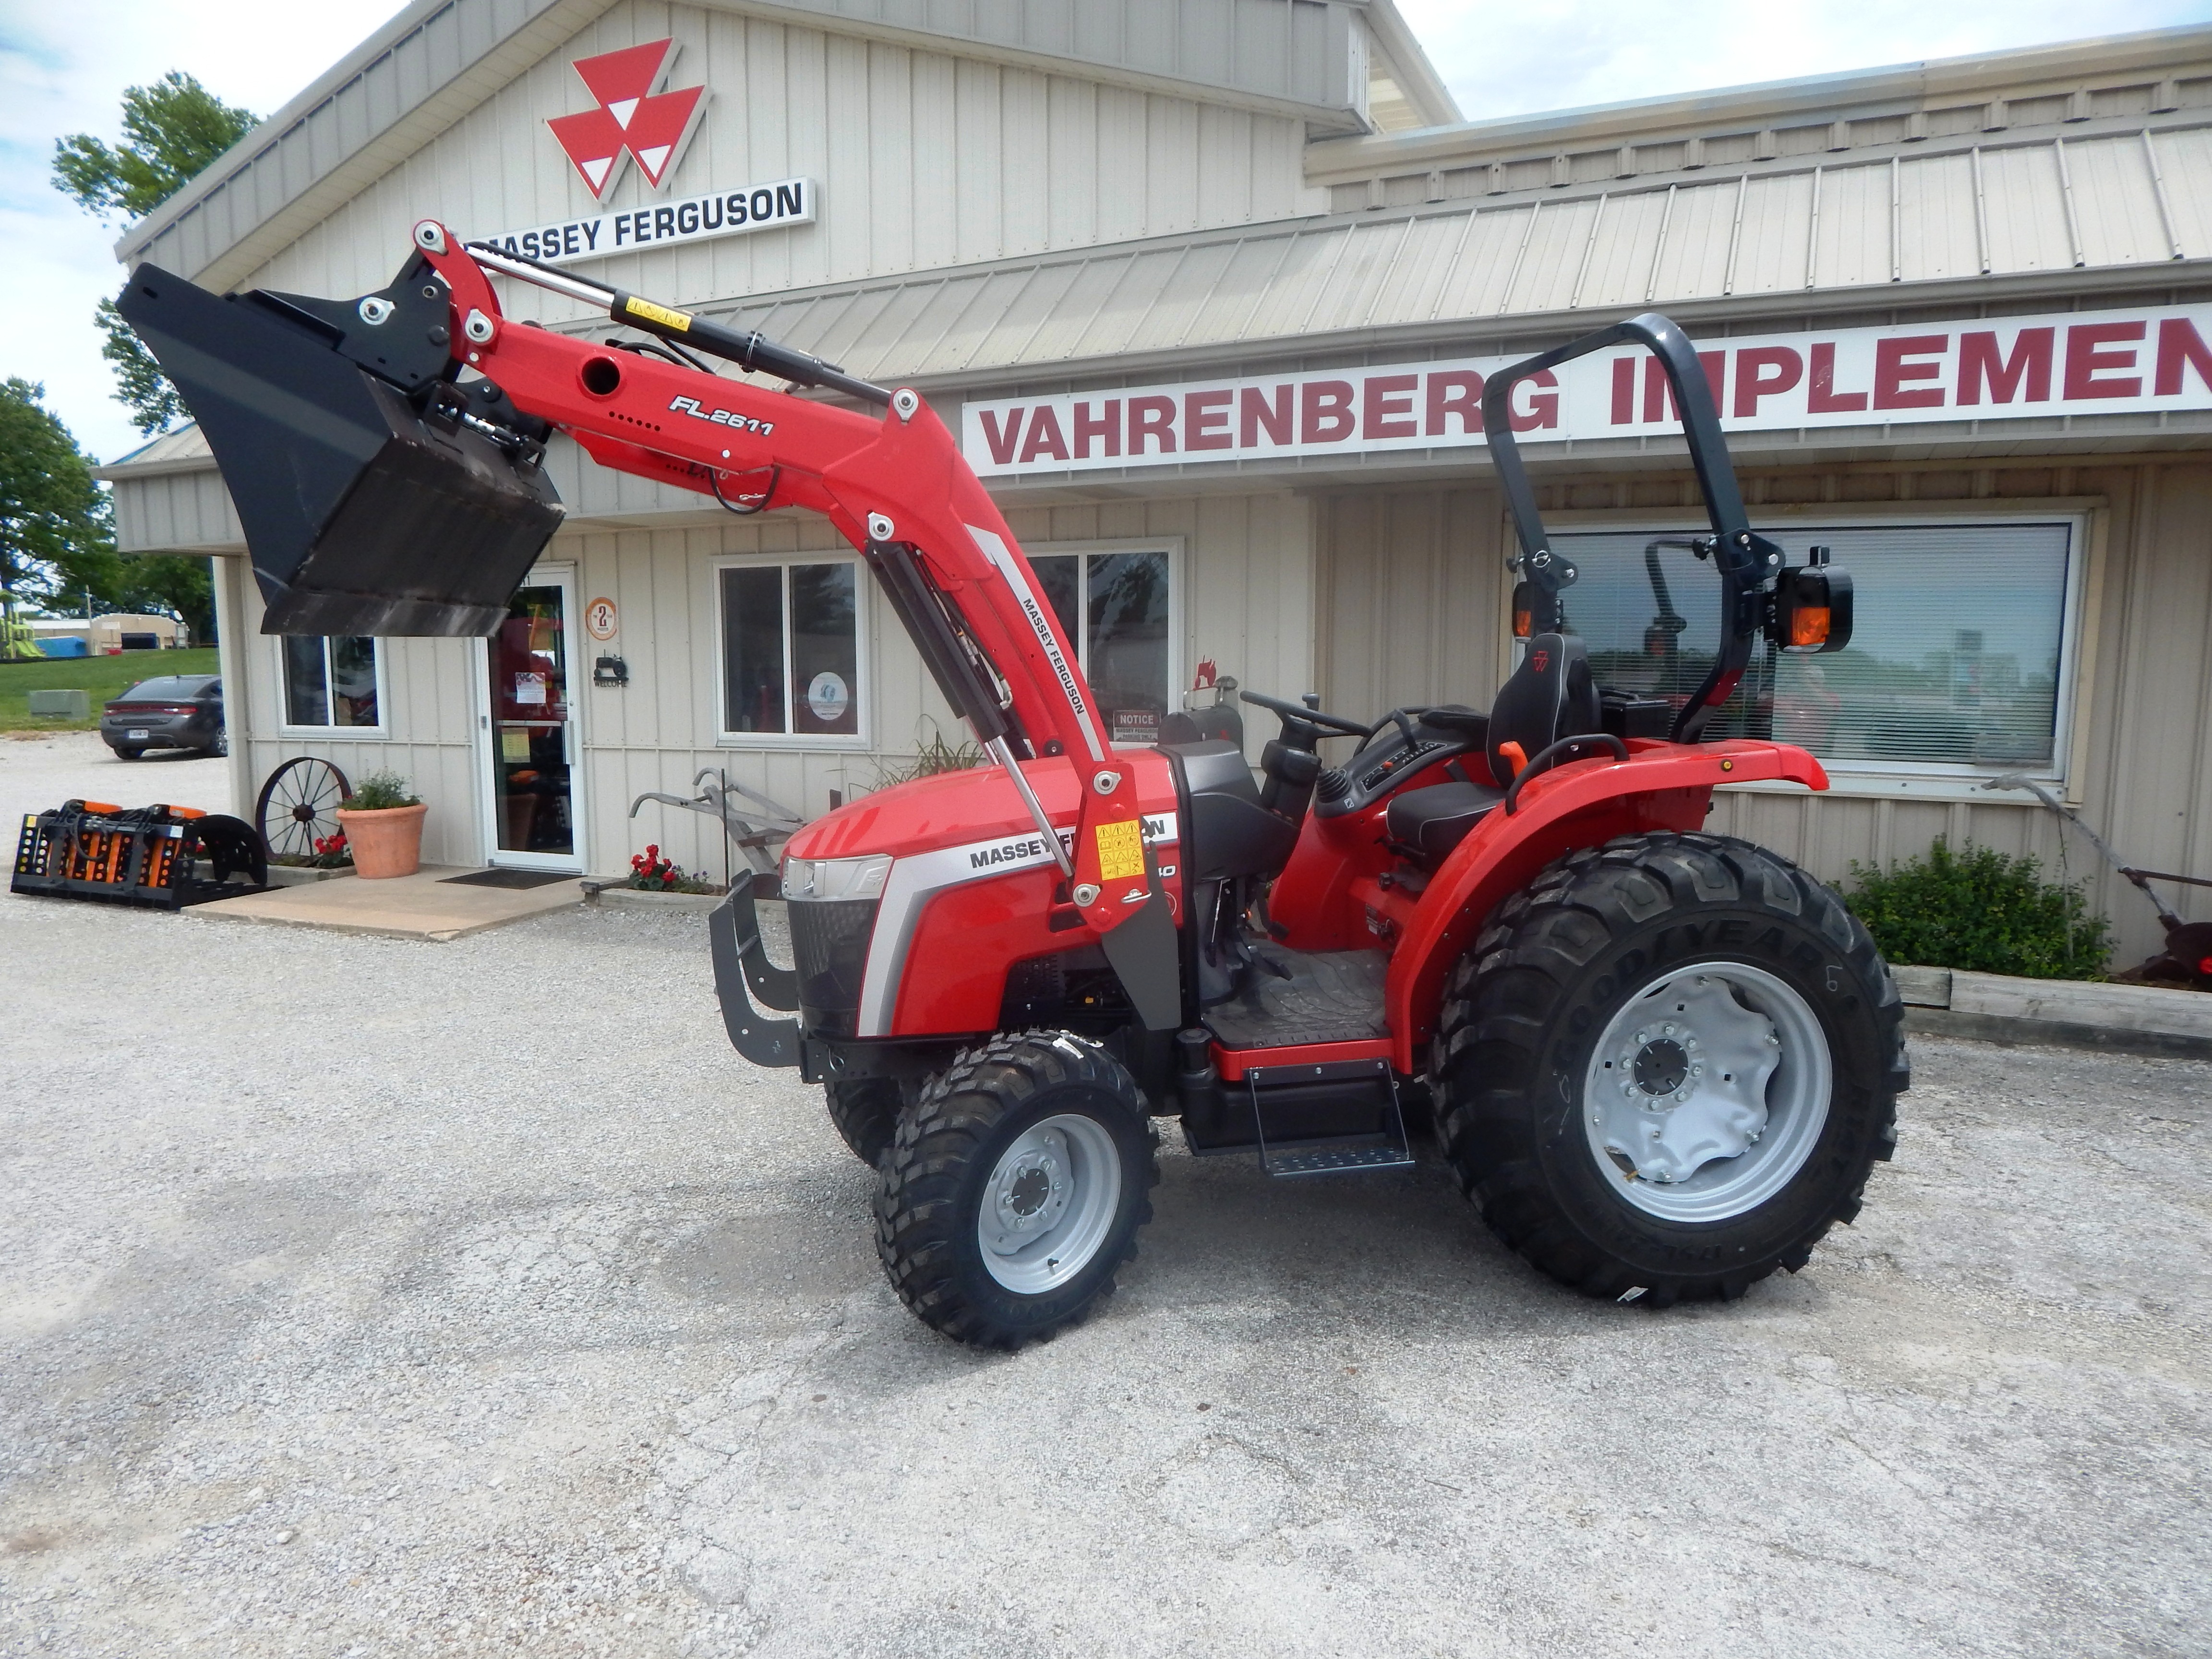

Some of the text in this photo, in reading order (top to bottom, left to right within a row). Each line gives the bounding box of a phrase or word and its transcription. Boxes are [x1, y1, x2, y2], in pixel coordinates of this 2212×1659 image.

[615, 182, 802, 246] FERGUSON
[669, 394, 775, 435] FL.2611
[979, 368, 1559, 464] VAHRENBERG
[598, 605, 607, 627] 2
[1023, 598, 1085, 715] MASSEY FERGUSON
[1120, 714, 1154, 724] NOTICE
[970, 839, 1052, 869] MASSEY
[1551, 918, 1826, 1071] GOODYEAR
